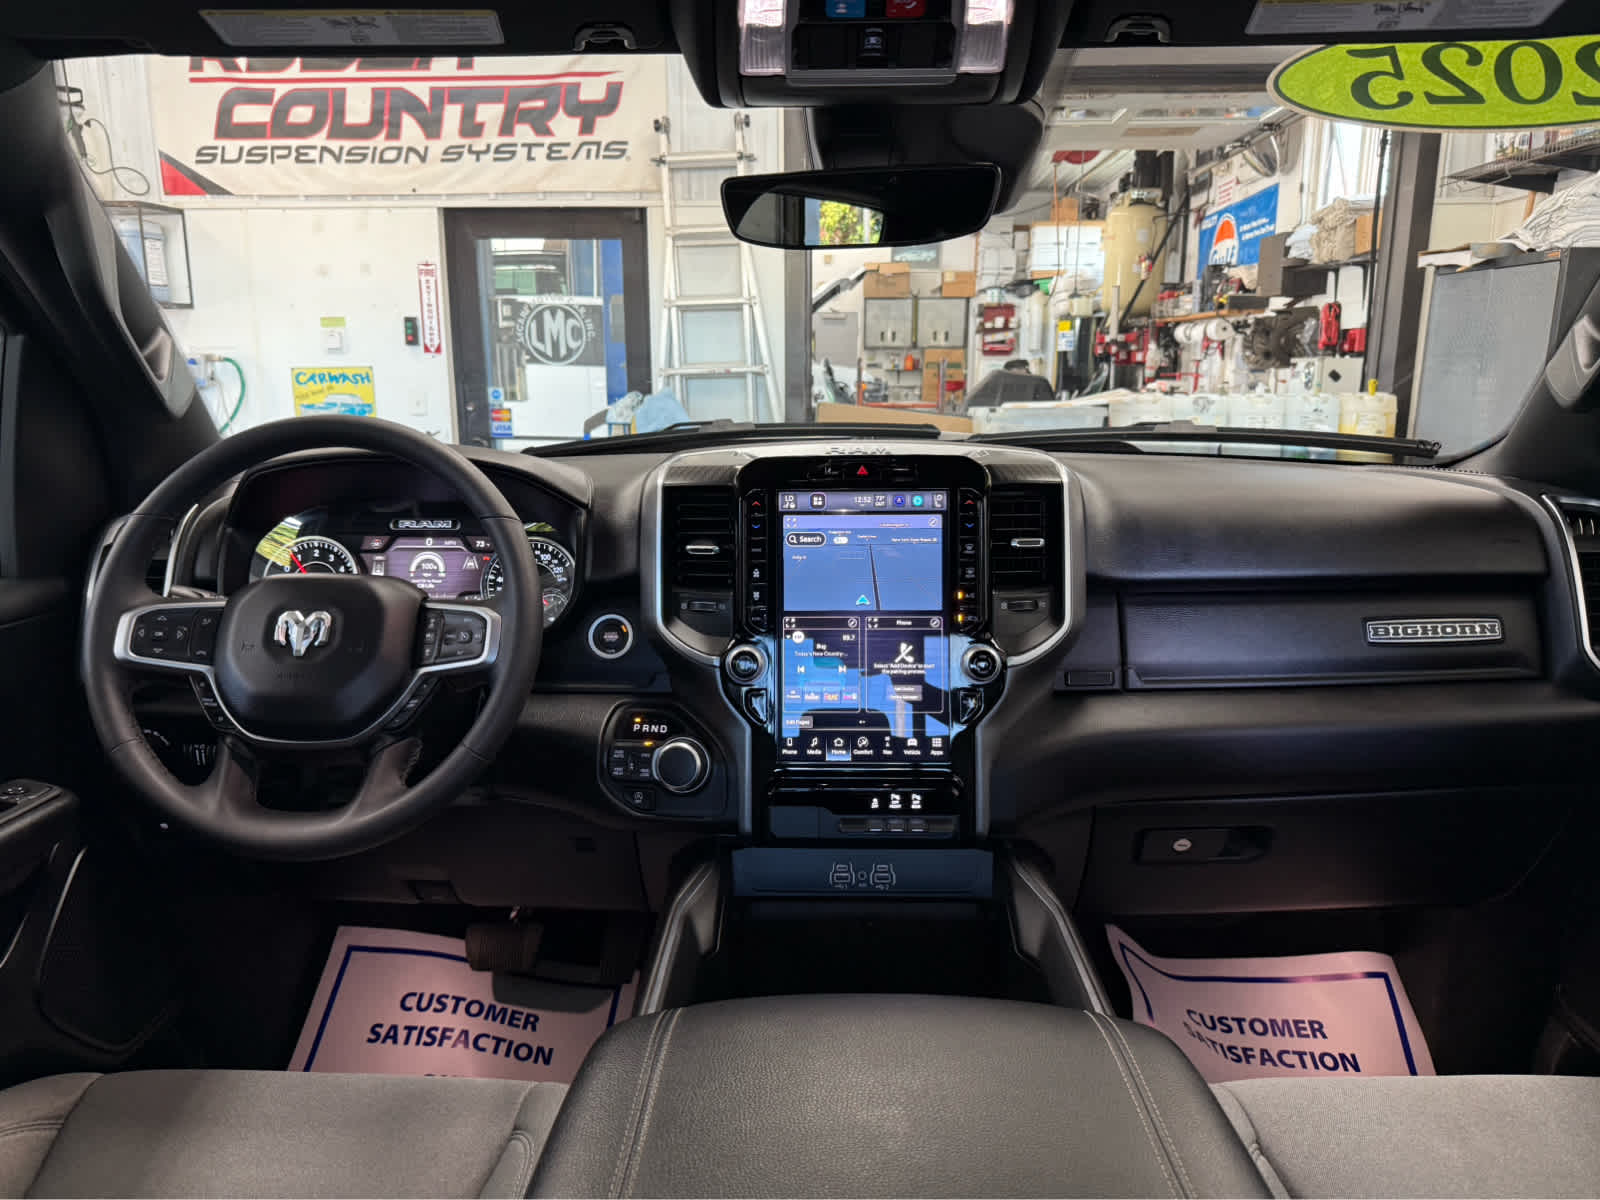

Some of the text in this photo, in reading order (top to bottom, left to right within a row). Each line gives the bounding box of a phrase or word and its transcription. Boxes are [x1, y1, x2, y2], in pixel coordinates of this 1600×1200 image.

[214, 81, 624, 141] COUNTRY
[195, 140, 628, 165] SUSPENSION SYSTEMS
[530, 308, 582, 359] LMC
[294, 371, 372, 386] CARWASH
[398, 520, 452, 529] RAM
[799, 536, 822, 544] Search
[313, 549, 320, 557] 2
[328, 554, 335, 562] 3
[1370, 623, 1498, 637] BIGHORN
[400, 992, 540, 1032] CUSTOMER
[1186, 1009, 1328, 1039] CUSTOMER
[366, 1023, 554, 1066] SATISFACTION
[1183, 1021, 1361, 1073] SATISFACTION
